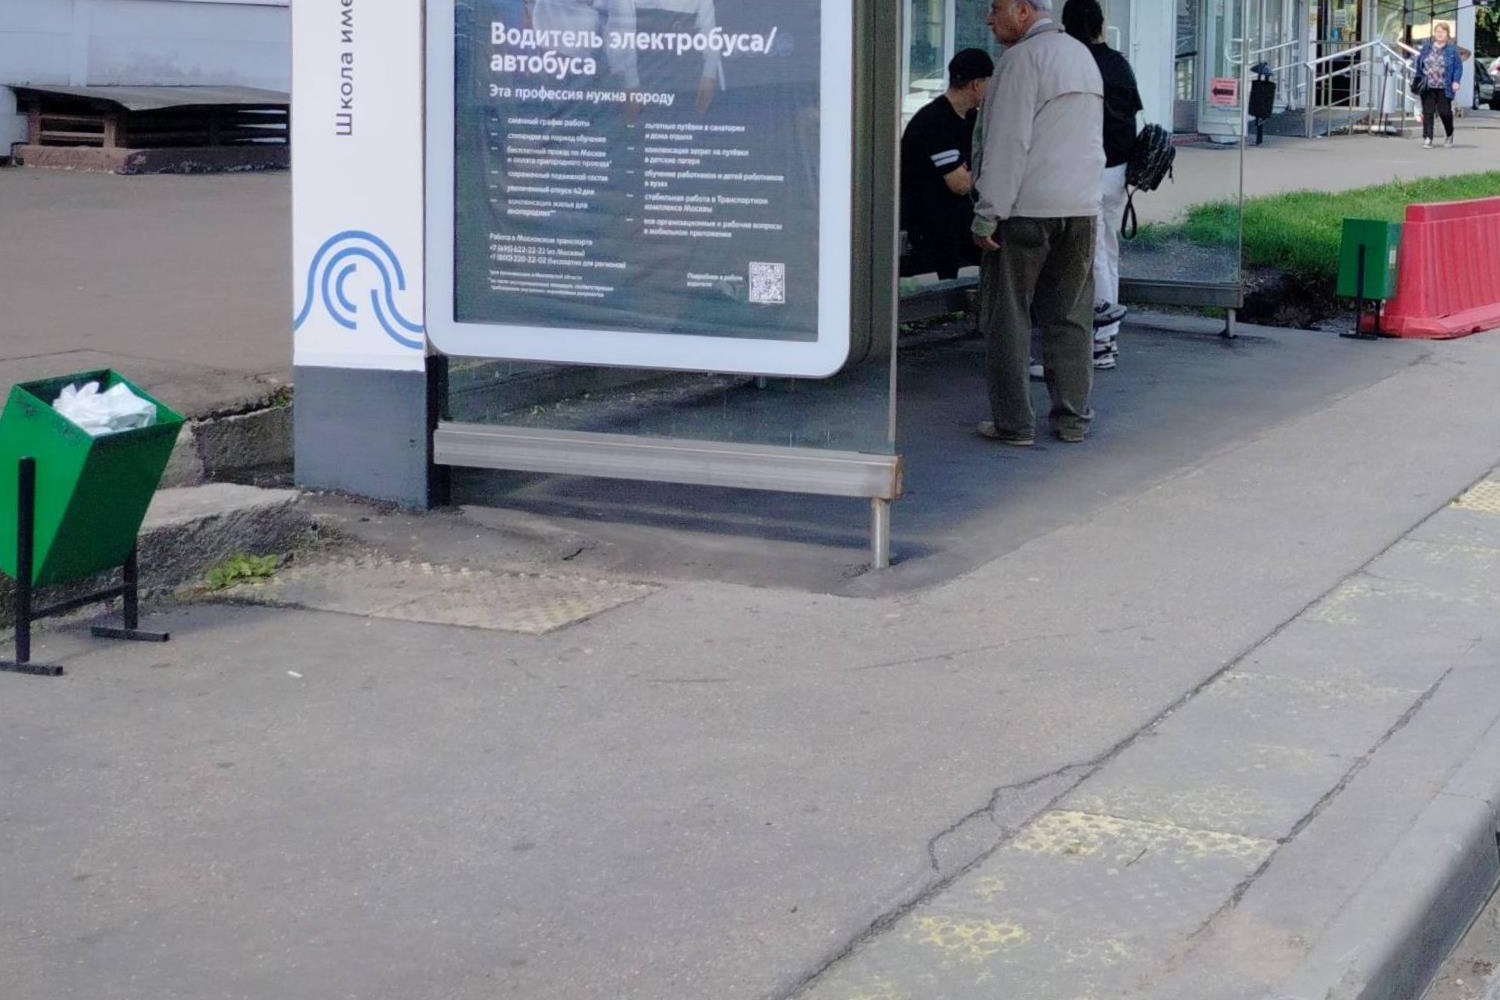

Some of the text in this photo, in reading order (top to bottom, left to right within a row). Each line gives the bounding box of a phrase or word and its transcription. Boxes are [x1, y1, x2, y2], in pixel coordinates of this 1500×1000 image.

[491, 22, 778, 56] Водитель электробуса/
[490, 51, 597, 80] автобуса
[336, 52, 353, 136] Школа
[489, 84, 675, 106] Эта профессия нужна городу
